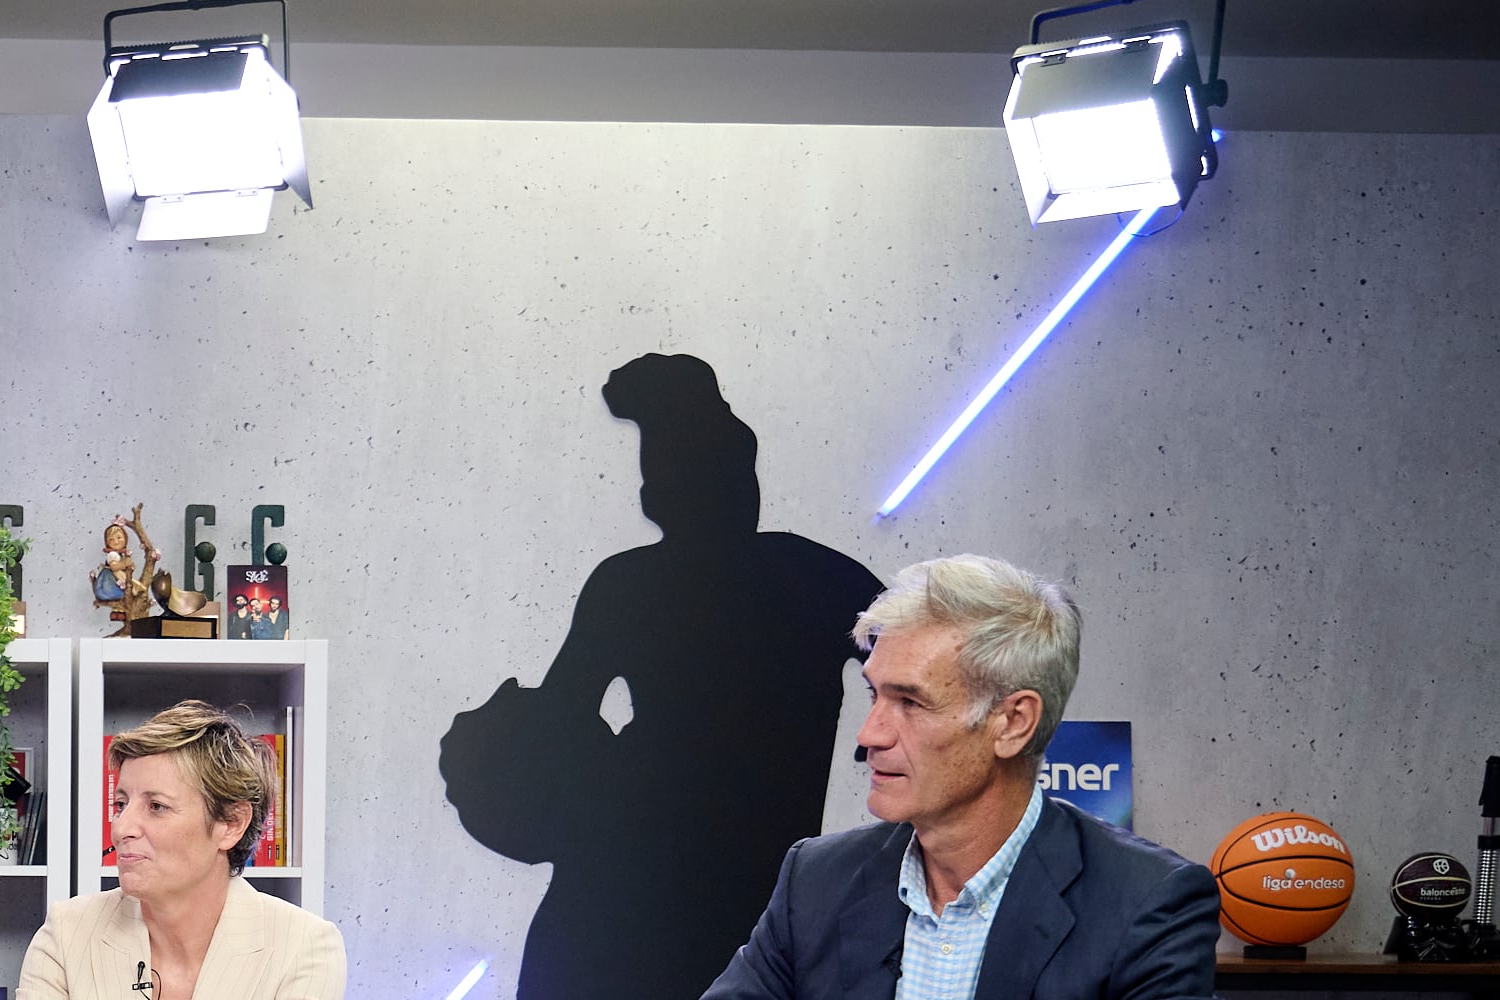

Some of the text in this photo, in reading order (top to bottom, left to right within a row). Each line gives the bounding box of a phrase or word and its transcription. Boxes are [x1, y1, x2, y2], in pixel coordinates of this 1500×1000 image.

[1251, 825, 1346, 854] Wilson
[1263, 875, 1345, 890] liga endesa
